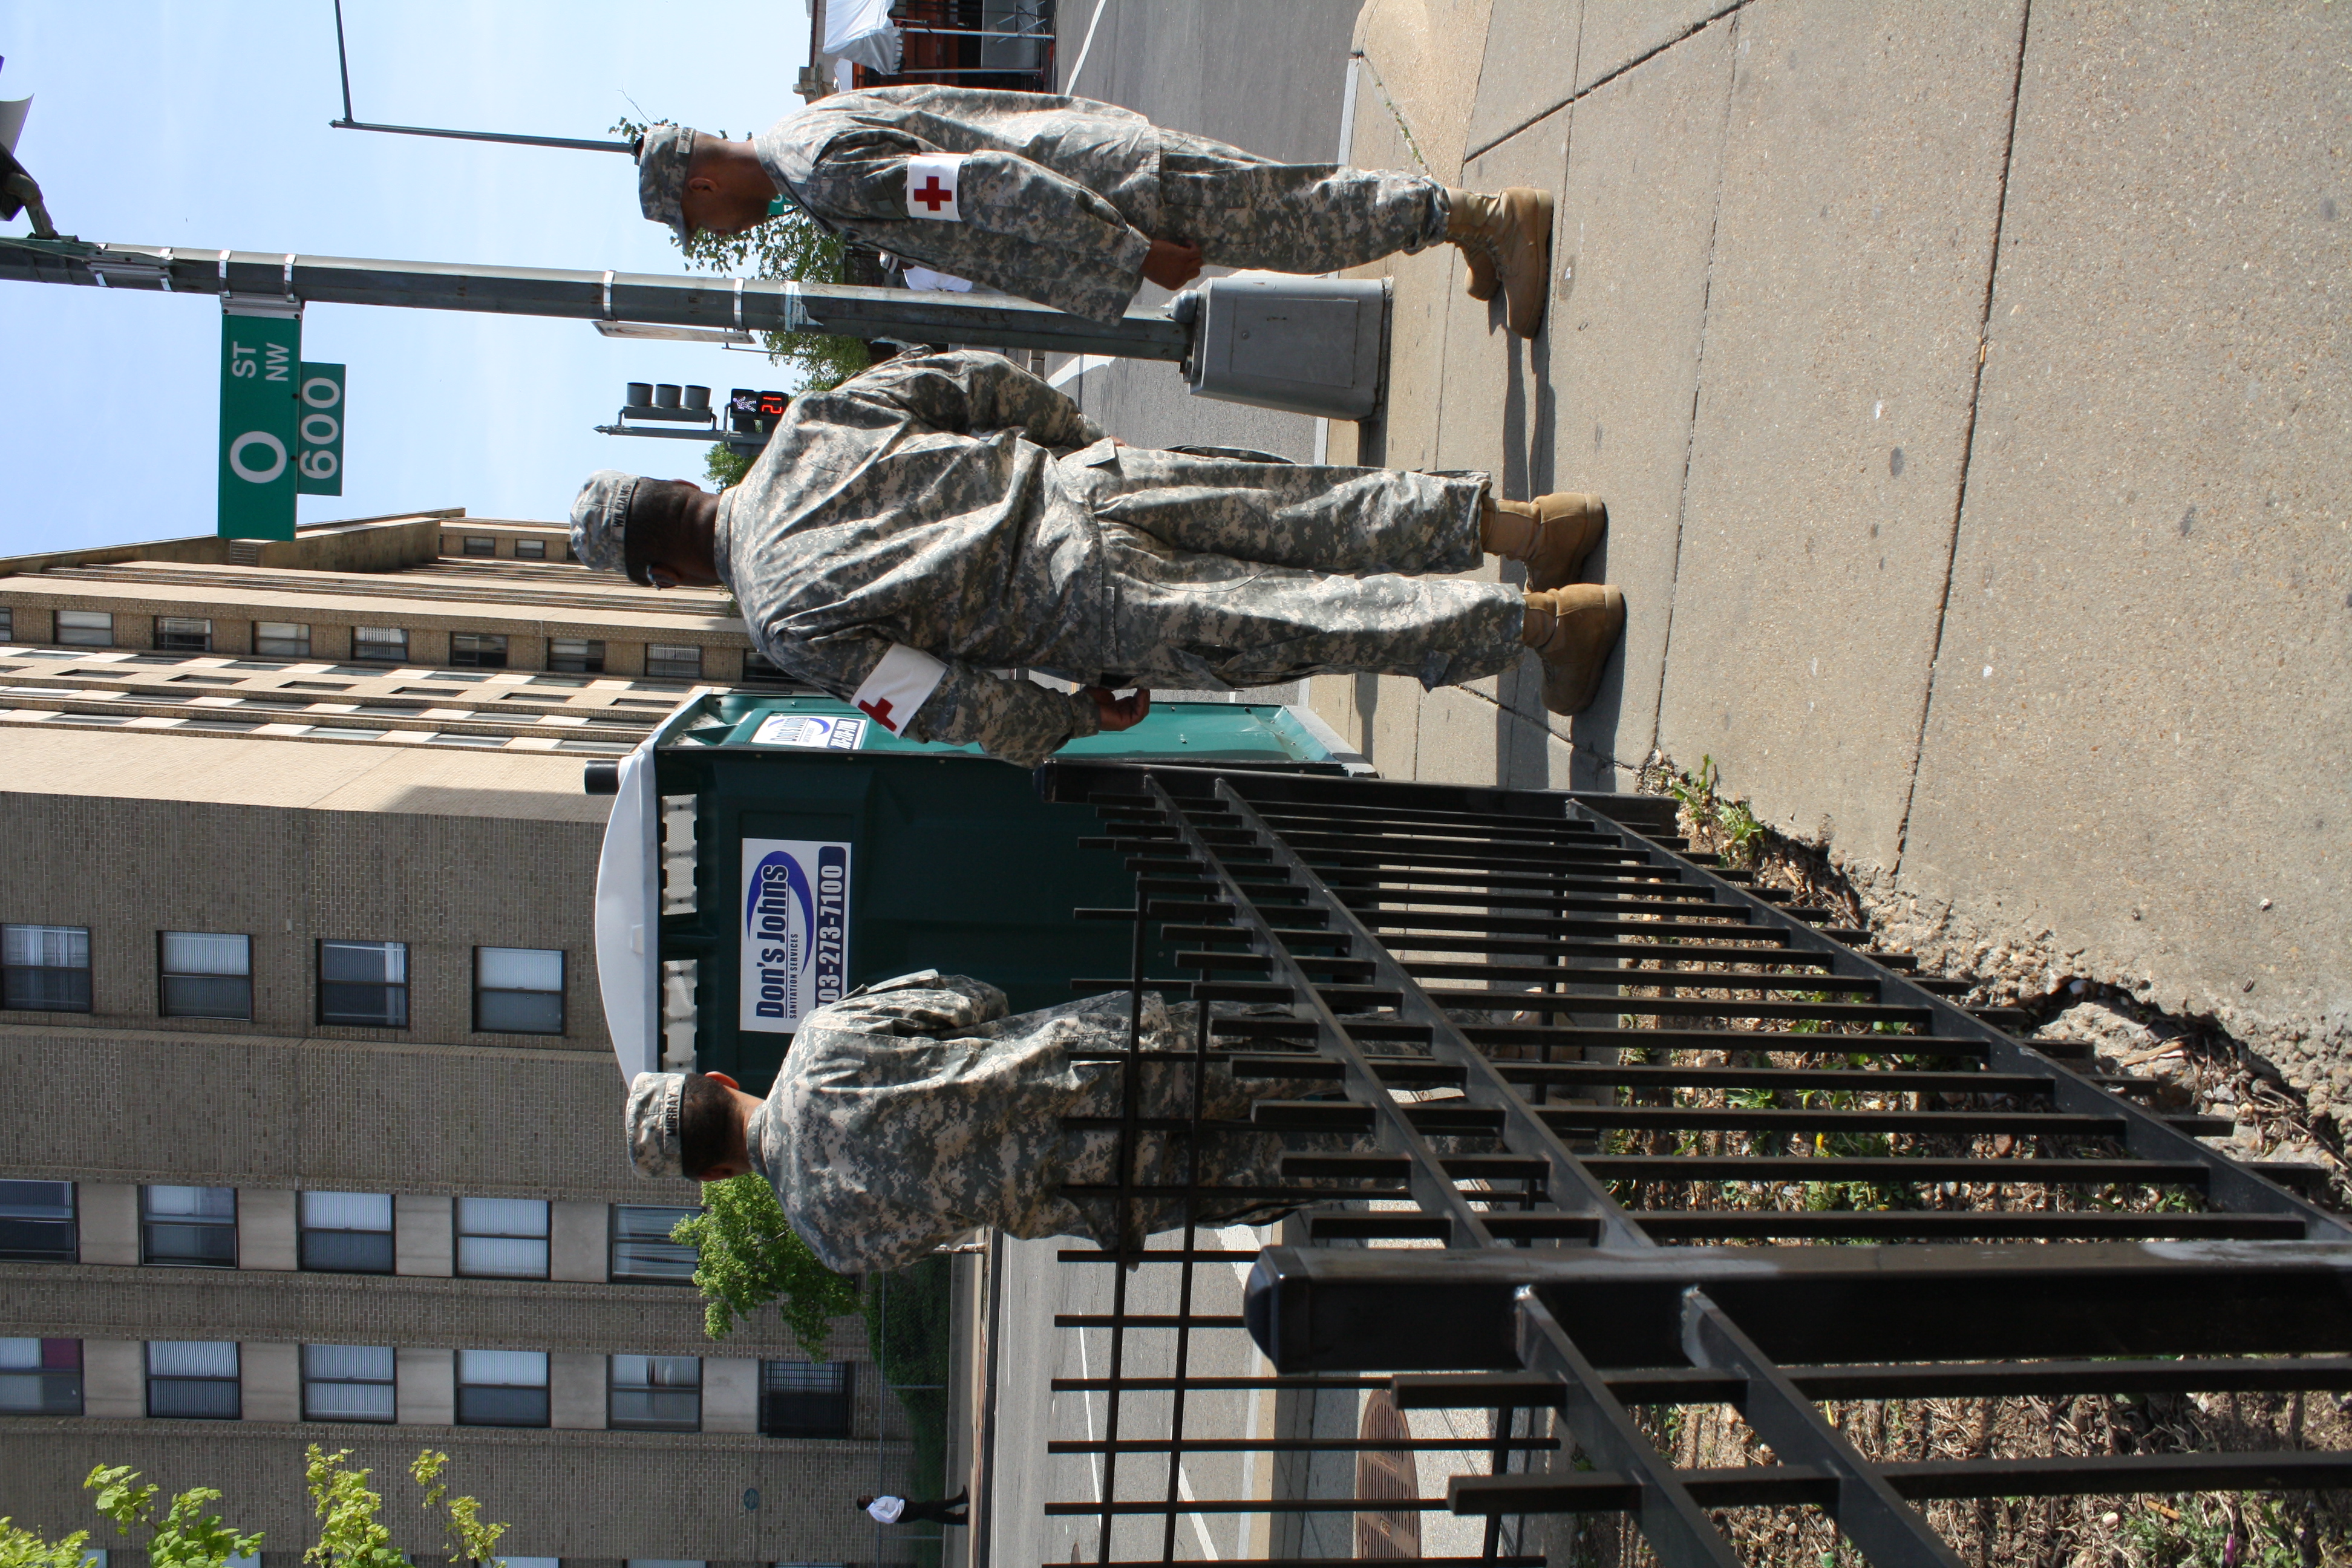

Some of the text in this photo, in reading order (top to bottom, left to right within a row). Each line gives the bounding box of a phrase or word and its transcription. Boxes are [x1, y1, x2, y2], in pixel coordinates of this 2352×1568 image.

[232, 341, 256, 378] ST
[266, 342, 290, 382] NW
[762, 396, 783, 414] 21
[299, 377, 341, 480] 600
[230, 431, 287, 483] O
[613, 485, 632, 528] WILLIAMS
[769, 728, 801, 742] Don's
[756, 864, 788, 1019] Don's Johns
[818, 865, 843, 1004] 03-273-7100
[789, 933, 799, 1019] SANITATION SERVICES
[665, 1093, 679, 1137] MURRAY
